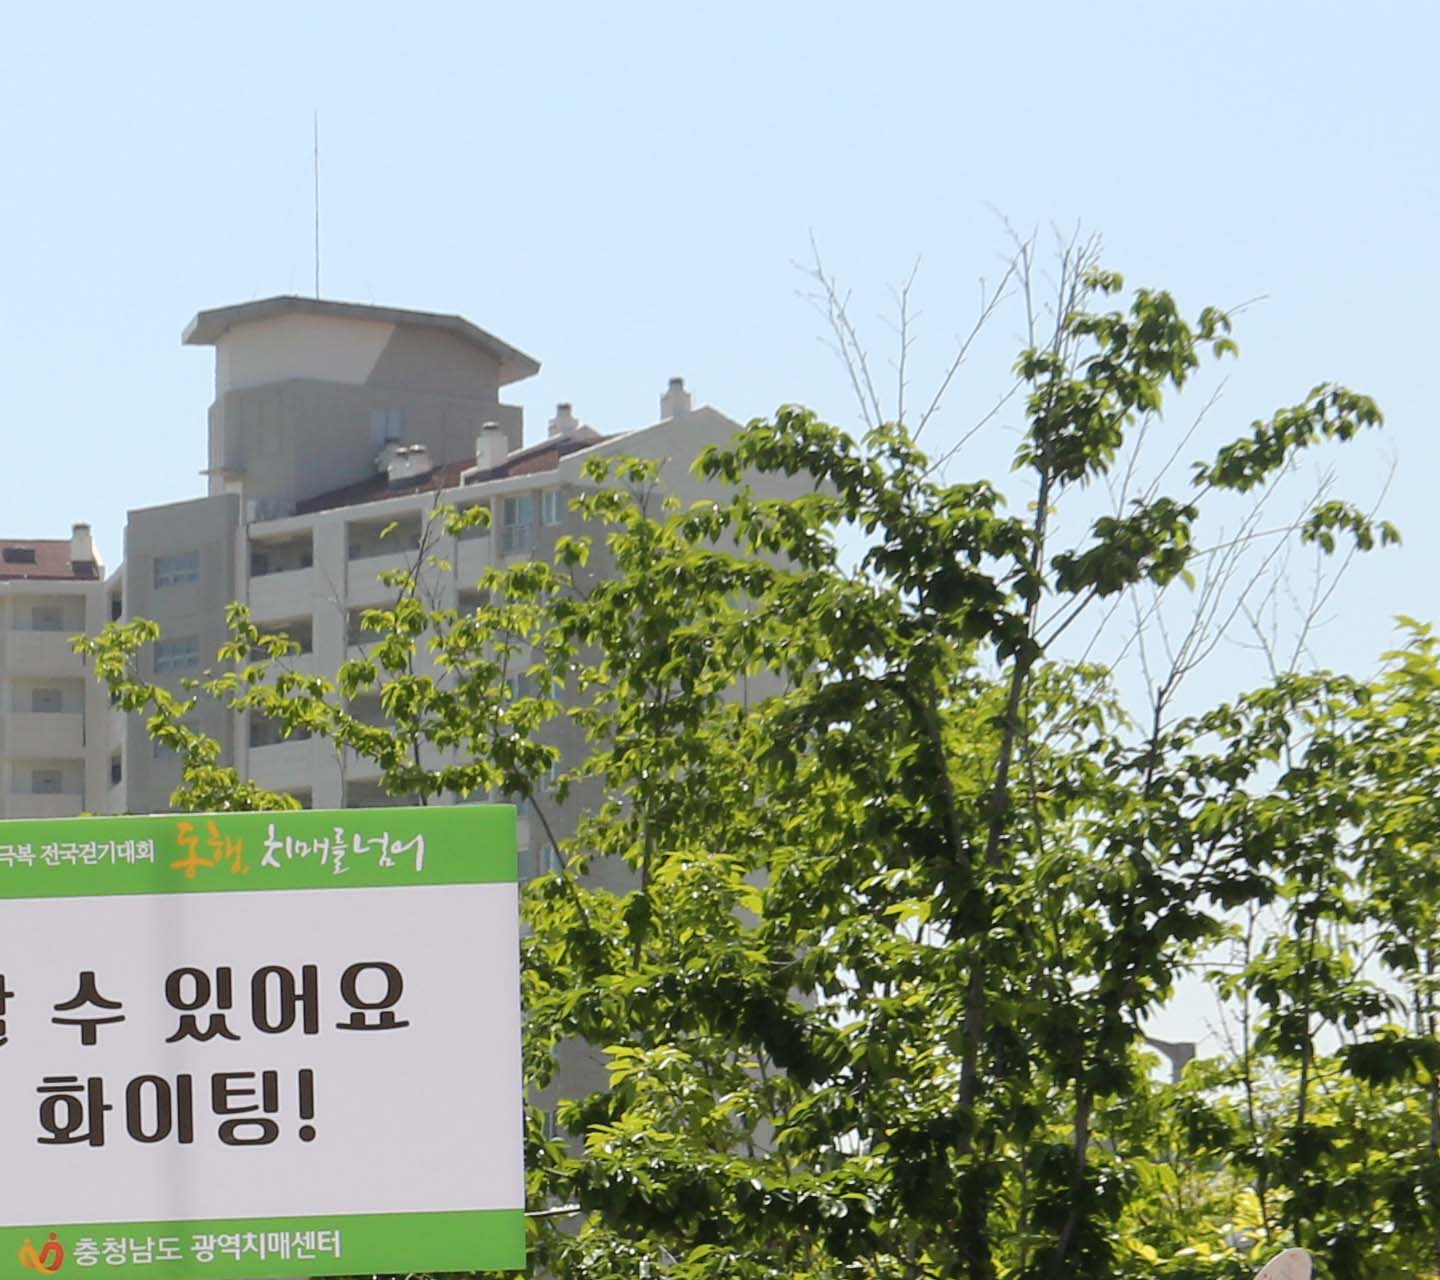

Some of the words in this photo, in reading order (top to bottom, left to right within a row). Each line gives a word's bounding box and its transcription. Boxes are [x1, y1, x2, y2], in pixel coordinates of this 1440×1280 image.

[39, 839, 156, 867] 전국걷기대회
[51, 971, 126, 1046] 수
[164, 961, 411, 1044] 있어요
[36, 1069, 318, 1147] 화이팅!
[72, 1236, 184, 1267] 충청남도
[191, 1230, 341, 1262] 광역치매센터
